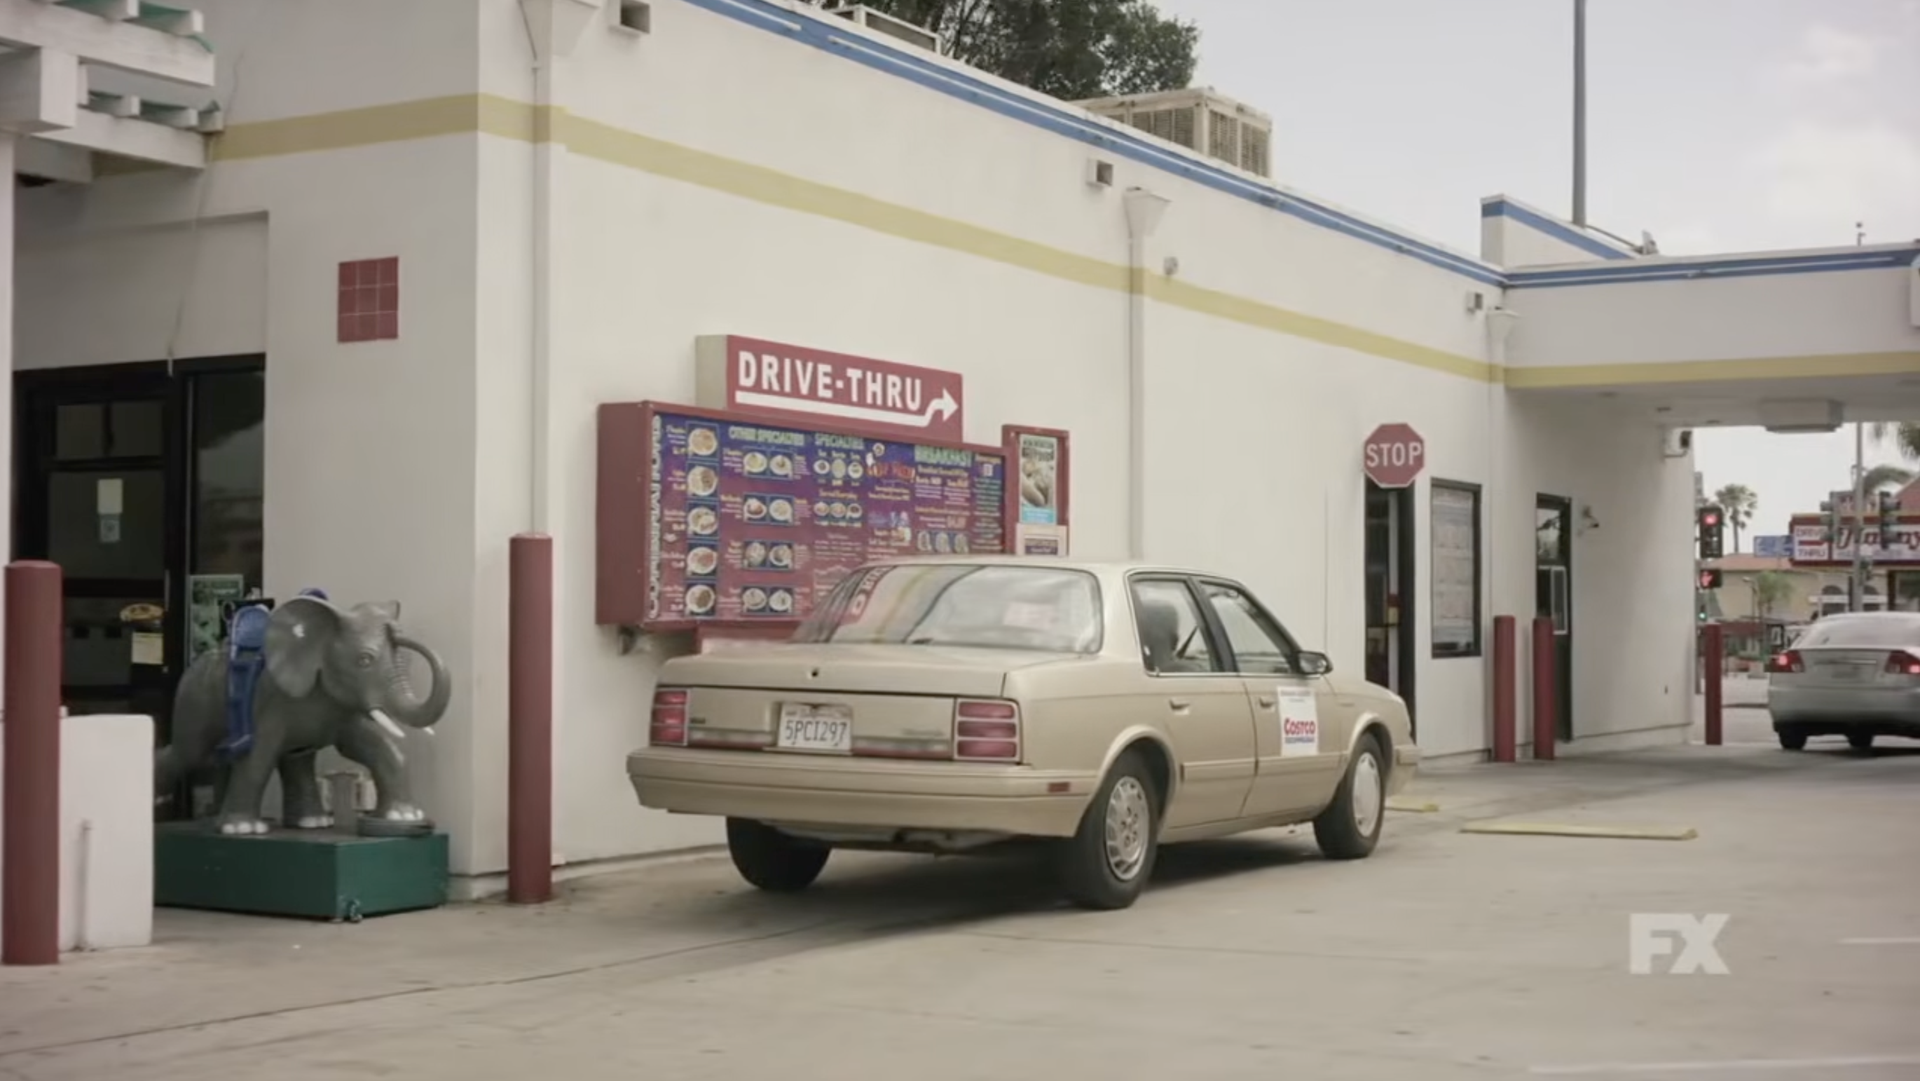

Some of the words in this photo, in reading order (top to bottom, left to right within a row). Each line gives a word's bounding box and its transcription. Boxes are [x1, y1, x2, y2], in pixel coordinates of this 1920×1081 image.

[738, 350, 921, 412] DRIVE-THRU
[1366, 442, 1422, 468] STOP
[785, 719, 848, 743] 5PCI297
